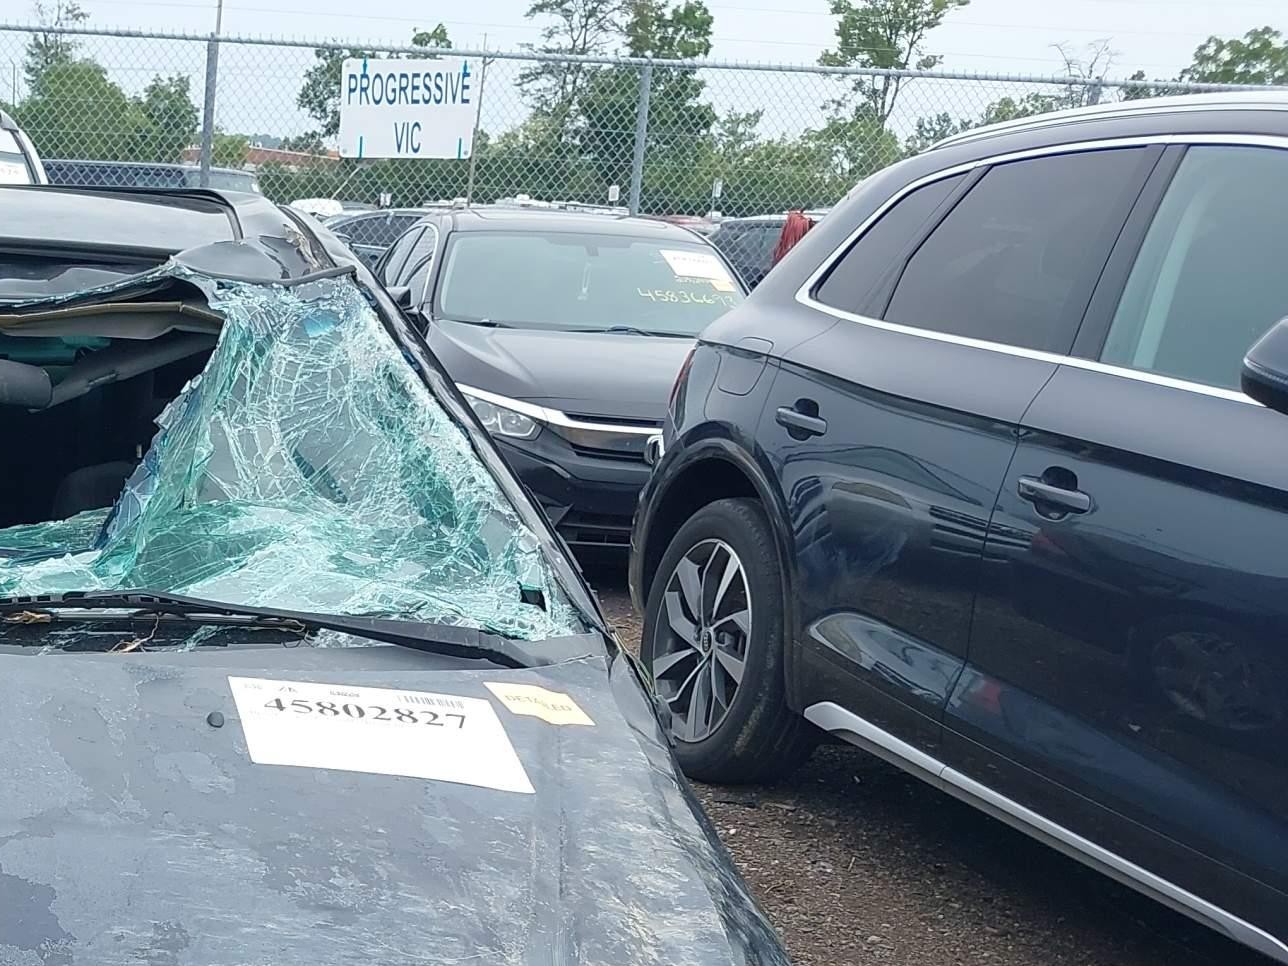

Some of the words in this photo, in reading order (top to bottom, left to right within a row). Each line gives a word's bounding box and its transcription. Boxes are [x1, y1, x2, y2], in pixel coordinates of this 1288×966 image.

[347, 72, 471, 105] PROGRESSIVE
[394, 121, 422, 154] VIC
[264, 698, 467, 729] 45802827
